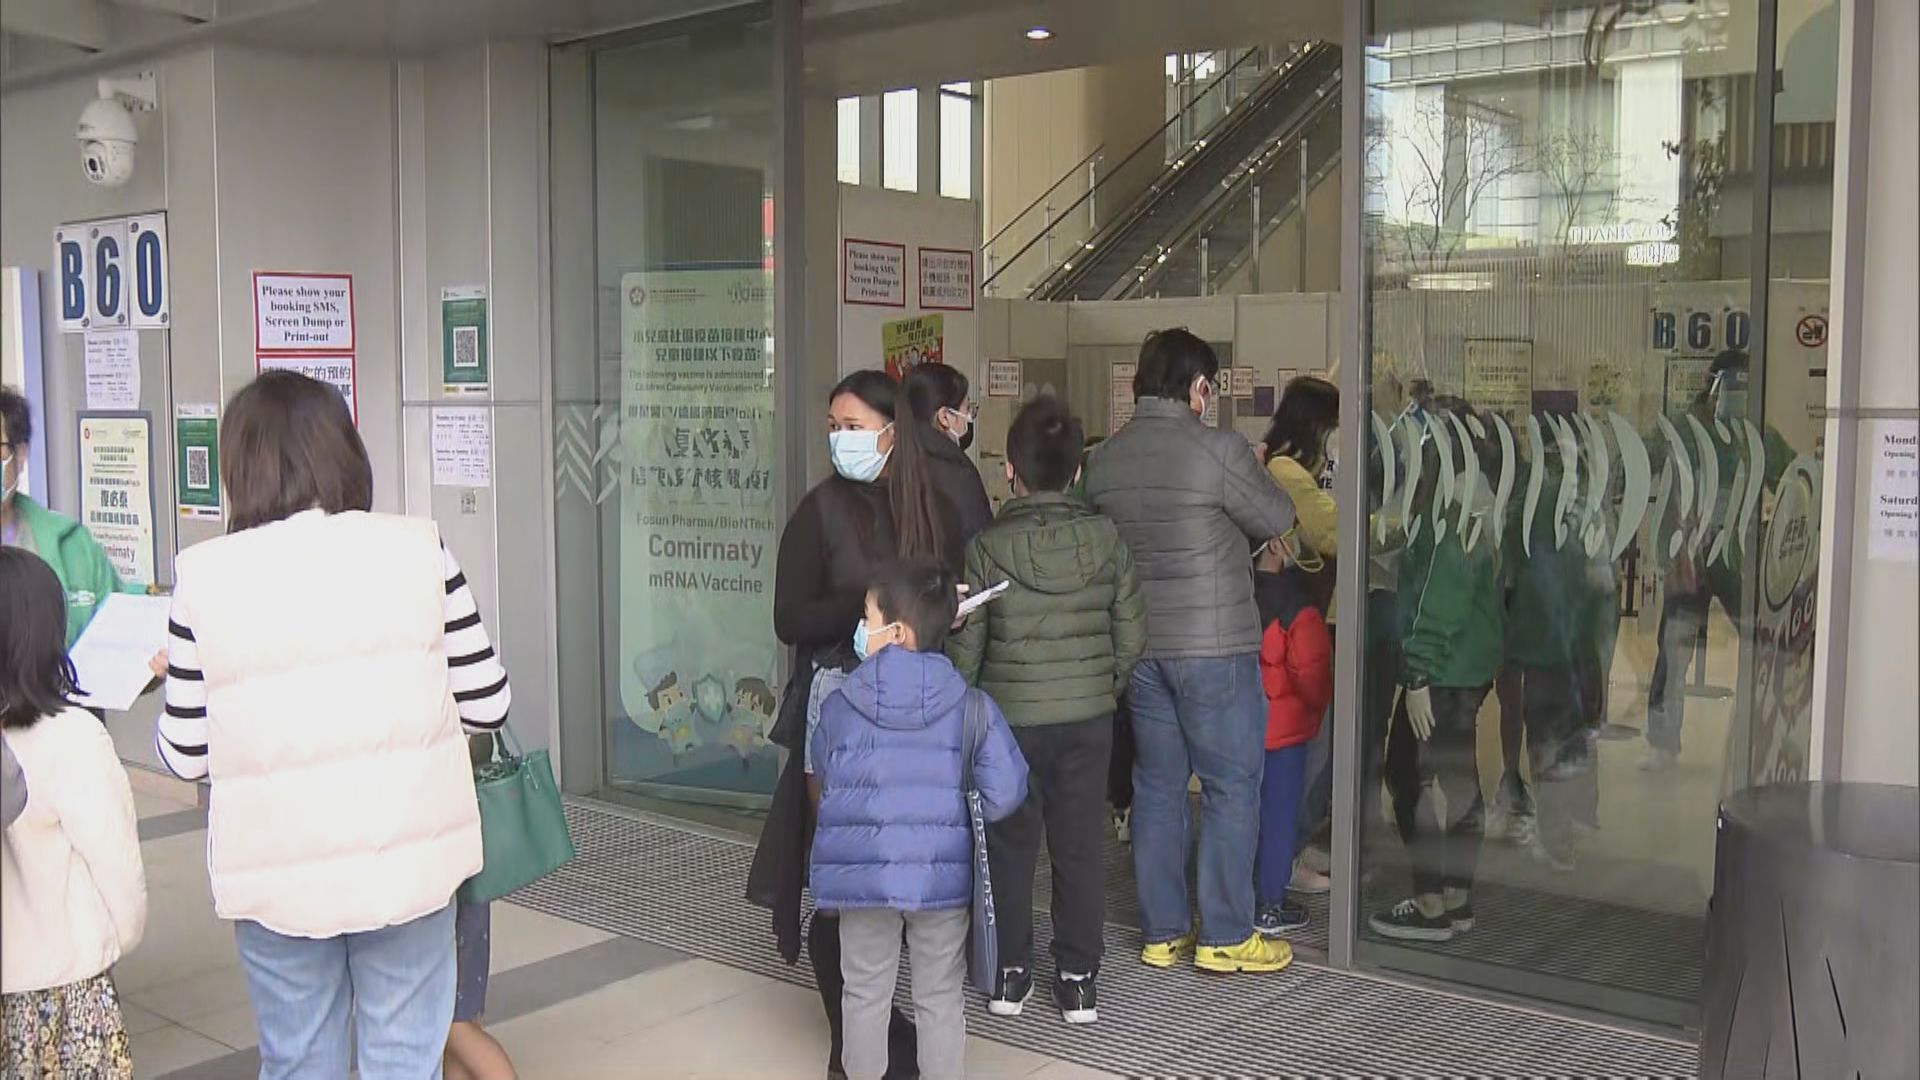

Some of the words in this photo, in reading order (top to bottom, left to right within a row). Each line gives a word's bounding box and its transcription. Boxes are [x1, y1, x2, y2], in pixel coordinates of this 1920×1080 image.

[1569, 225, 1633, 244] THANK
[849, 250, 868, 260] Please
[61, 230, 162, 320] B60
[853, 263, 879, 275] booking
[850, 275, 874, 285] Screen
[873, 276, 892, 287] Dump
[262, 285, 294, 297] Please
[296, 286, 320, 297] show
[323, 288, 346, 300] your
[861, 288, 890, 298] Print-out
[270, 300, 311, 313] booking
[313, 301, 340, 313] SMS,
[265, 315, 299, 327] Screen
[302, 316, 332, 329] Dump
[334, 319, 345, 328] or
[284, 331, 329, 342] Print-out
[678, 371, 704, 379] vaccine
[714, 371, 764, 380] administered
[710, 384, 753, 393] Vaccination
[1883, 450, 1916, 460] Opening
[1880, 509, 1913, 519] Opening
[637, 511, 669, 527] Fosun
[672, 513, 775, 532] Pharma/BioNTech
[649, 533, 764, 569] Comirnaty
[649, 570, 698, 590] mRNA
[701, 572, 763, 594] Vaccine
